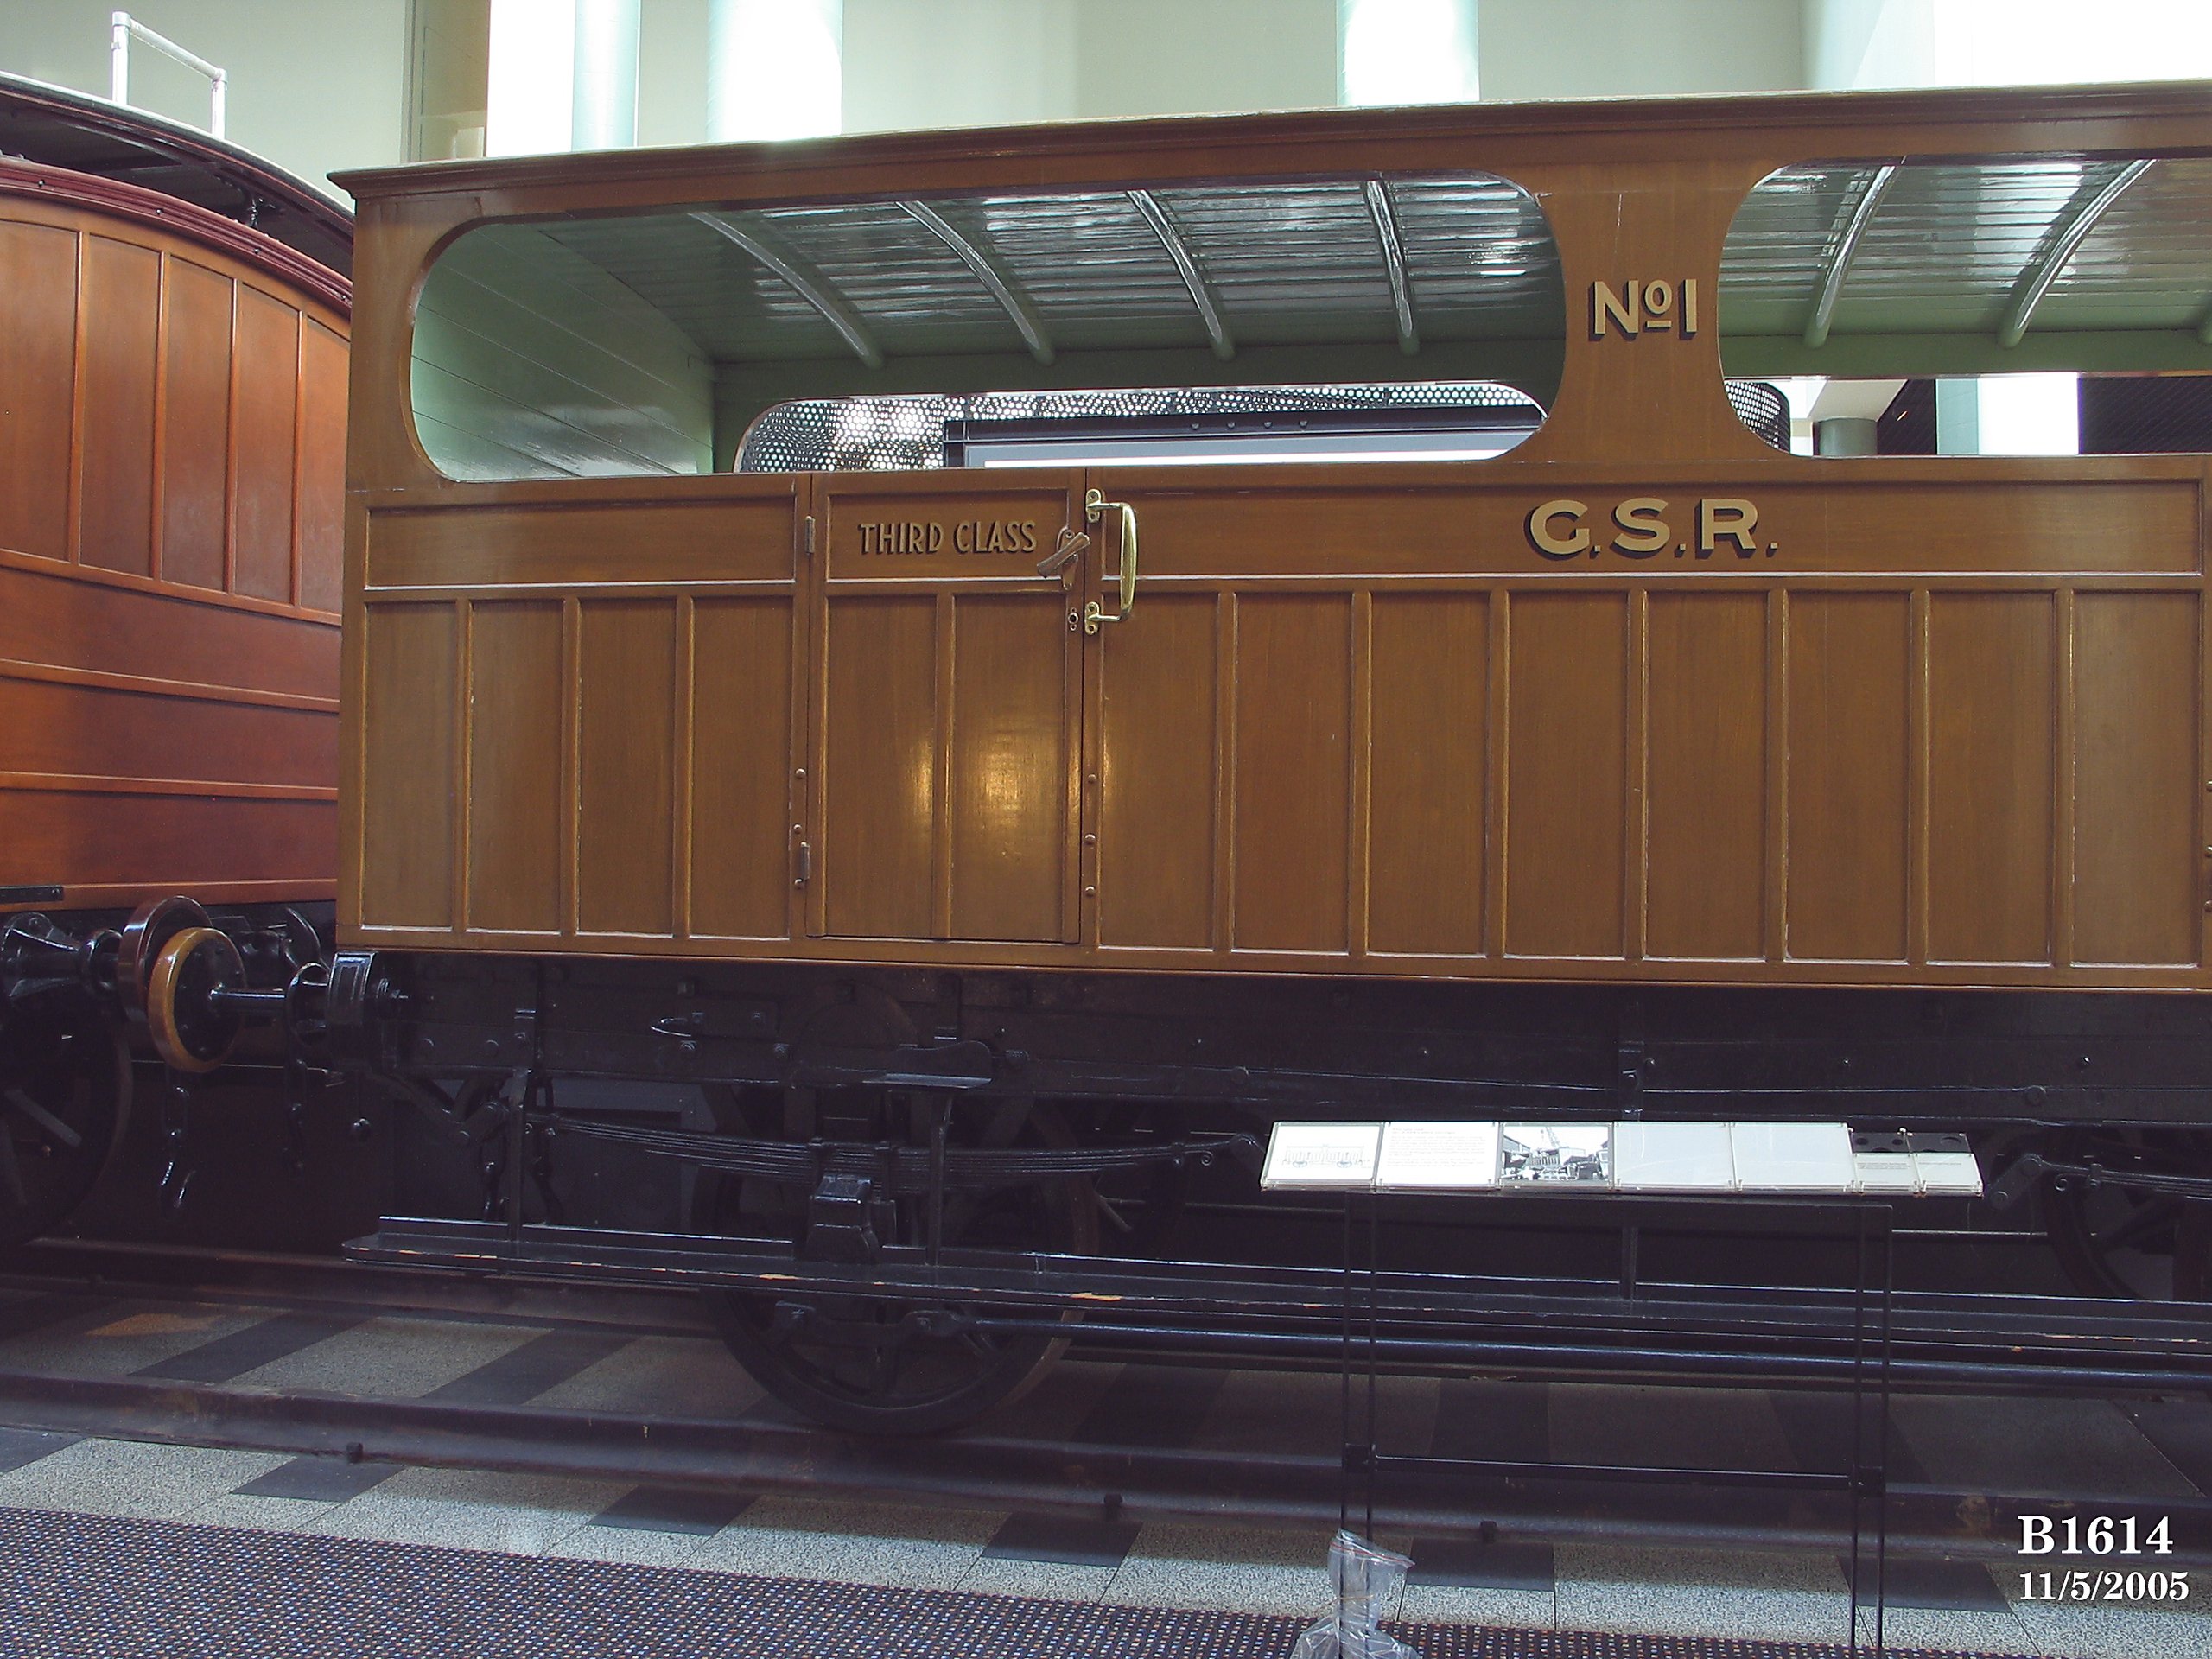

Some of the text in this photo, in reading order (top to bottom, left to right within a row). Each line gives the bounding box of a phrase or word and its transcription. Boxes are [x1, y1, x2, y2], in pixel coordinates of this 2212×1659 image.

[859, 520, 1037, 554] THIRD CLASS
[1525, 498, 1778, 559] G.S.R.
